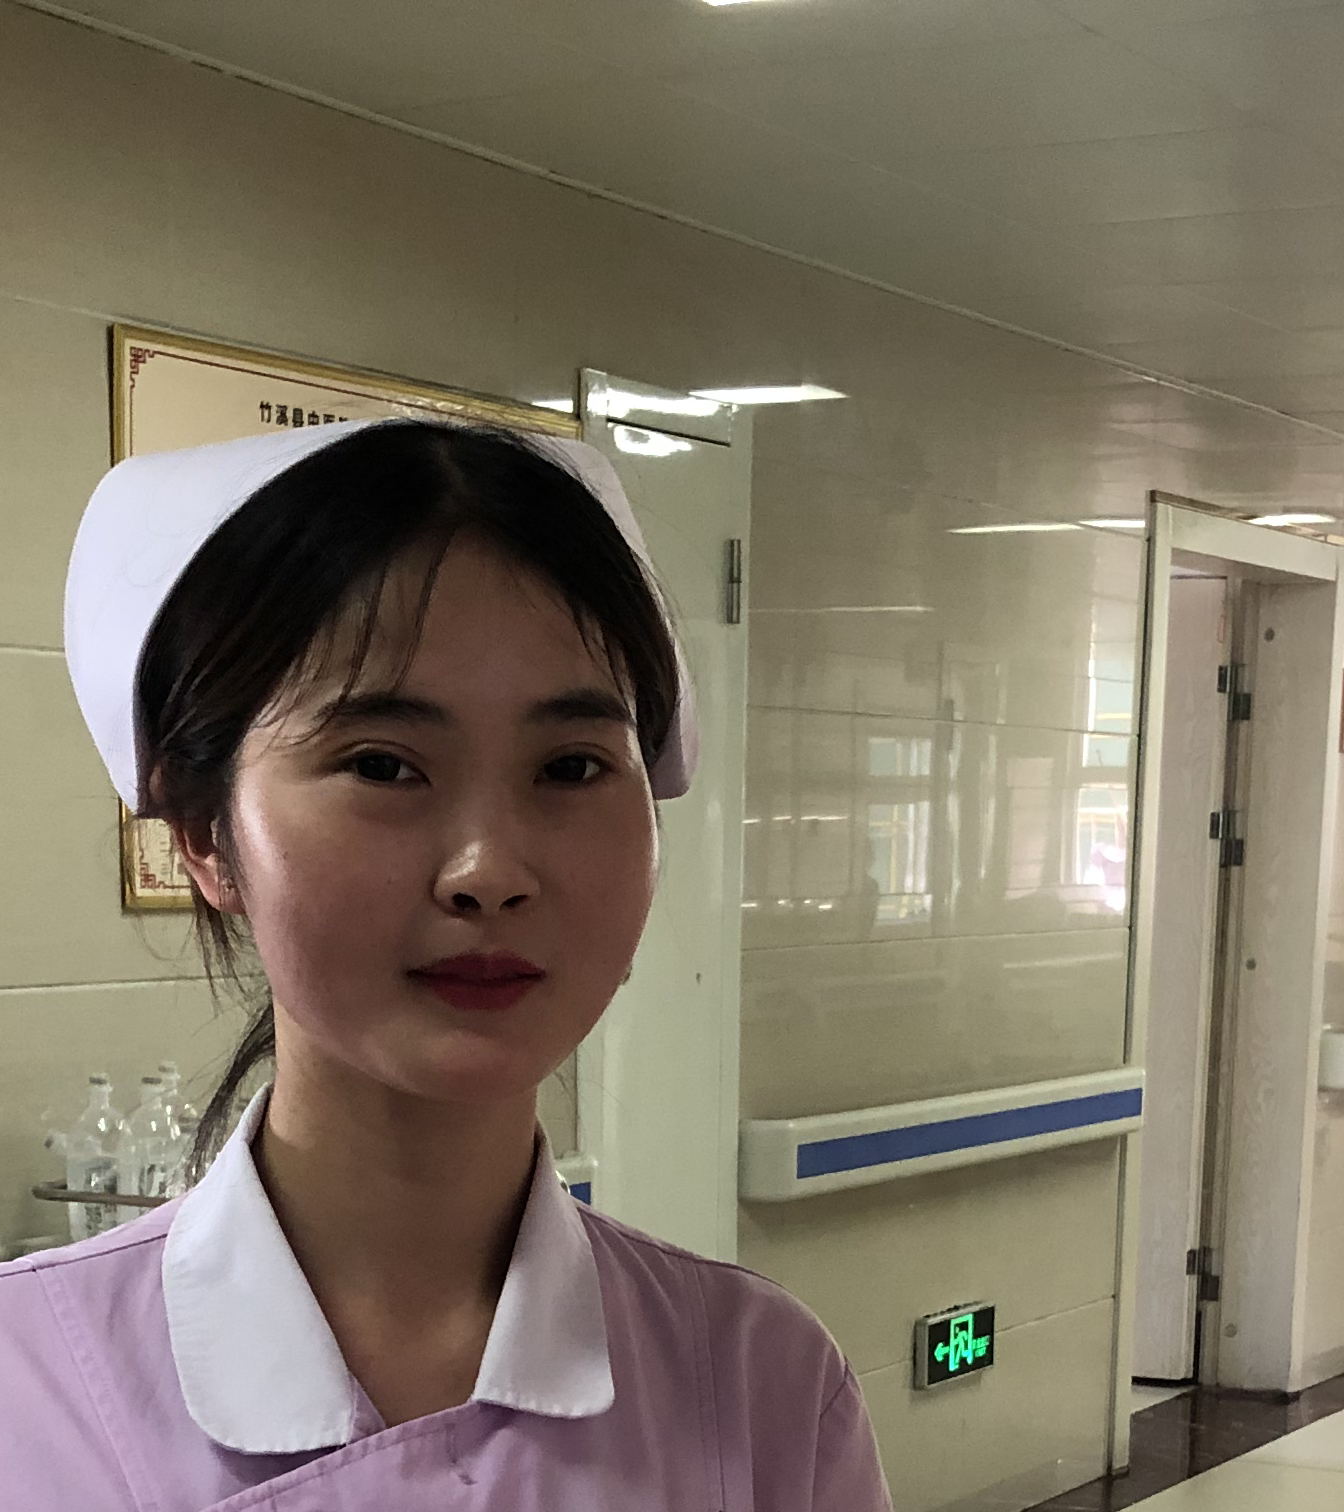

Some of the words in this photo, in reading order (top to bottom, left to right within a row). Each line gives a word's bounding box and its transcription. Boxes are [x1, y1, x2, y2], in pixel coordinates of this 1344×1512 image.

[259, 400, 348, 428] 竹溪县中医
